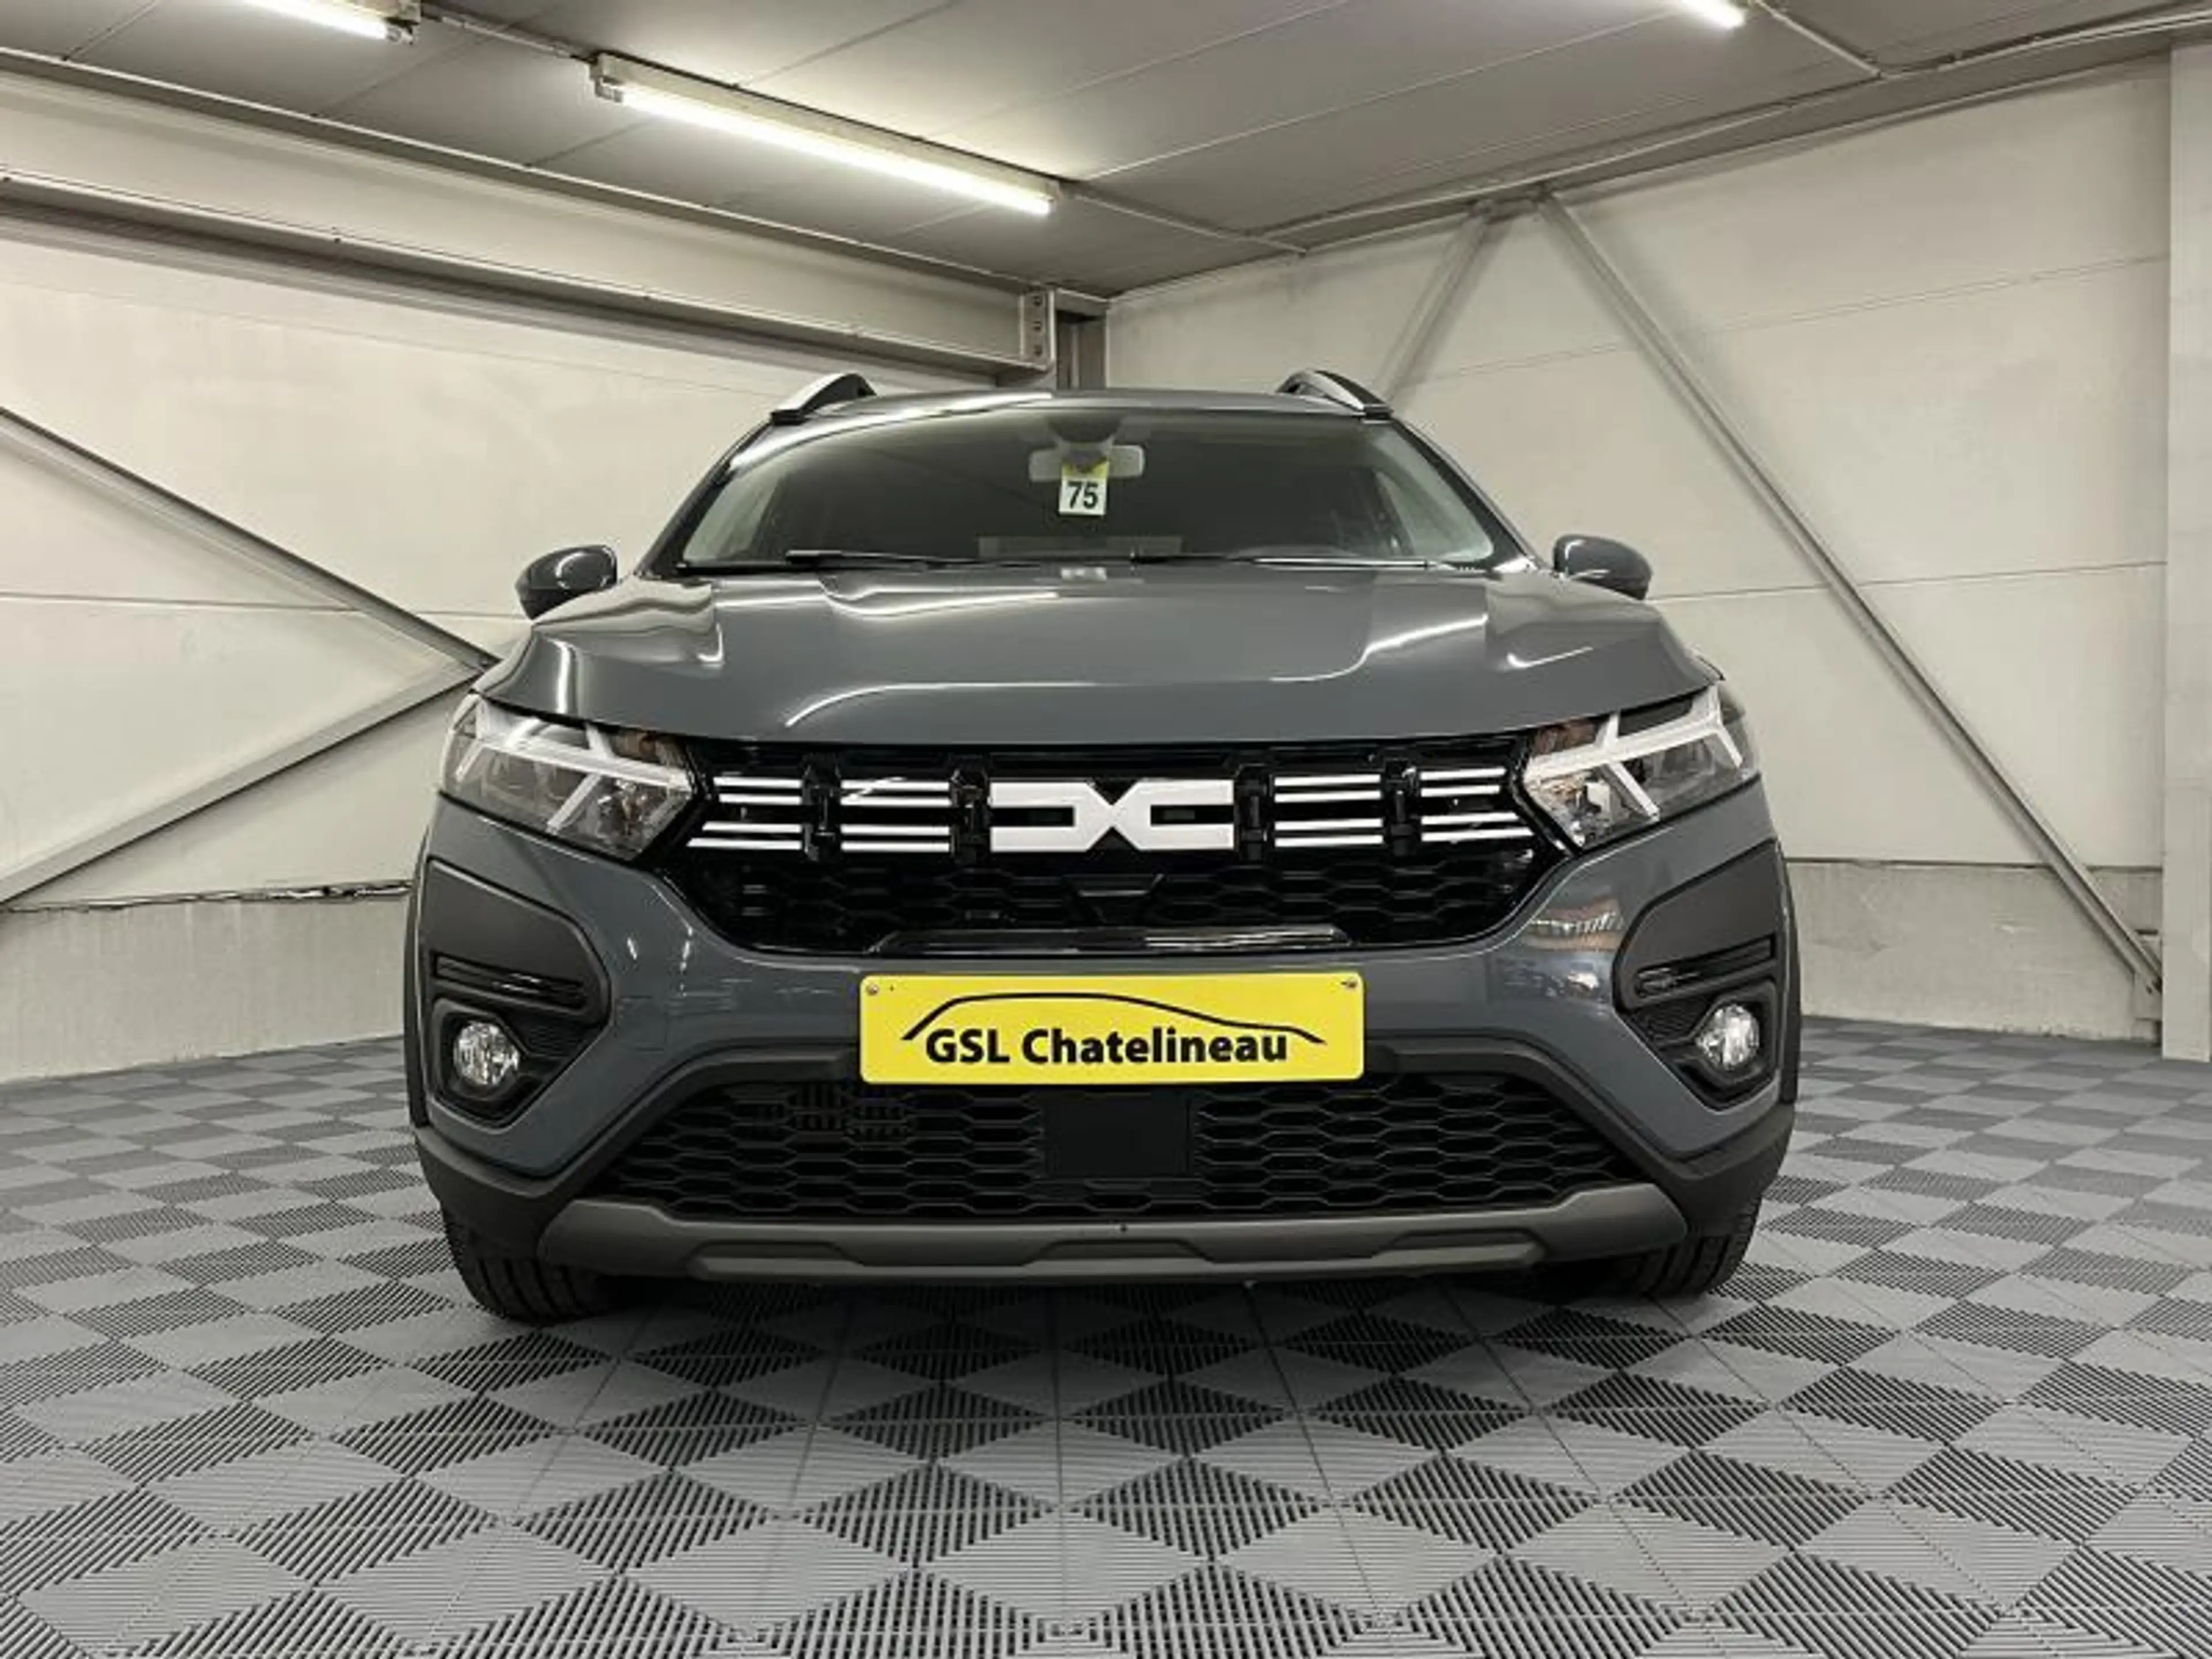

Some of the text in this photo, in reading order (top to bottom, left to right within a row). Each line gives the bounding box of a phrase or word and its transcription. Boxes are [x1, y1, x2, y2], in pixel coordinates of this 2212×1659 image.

[1067, 480, 1099, 509] 75
[926, 1027, 1287, 1064] GSL Chatelineau
